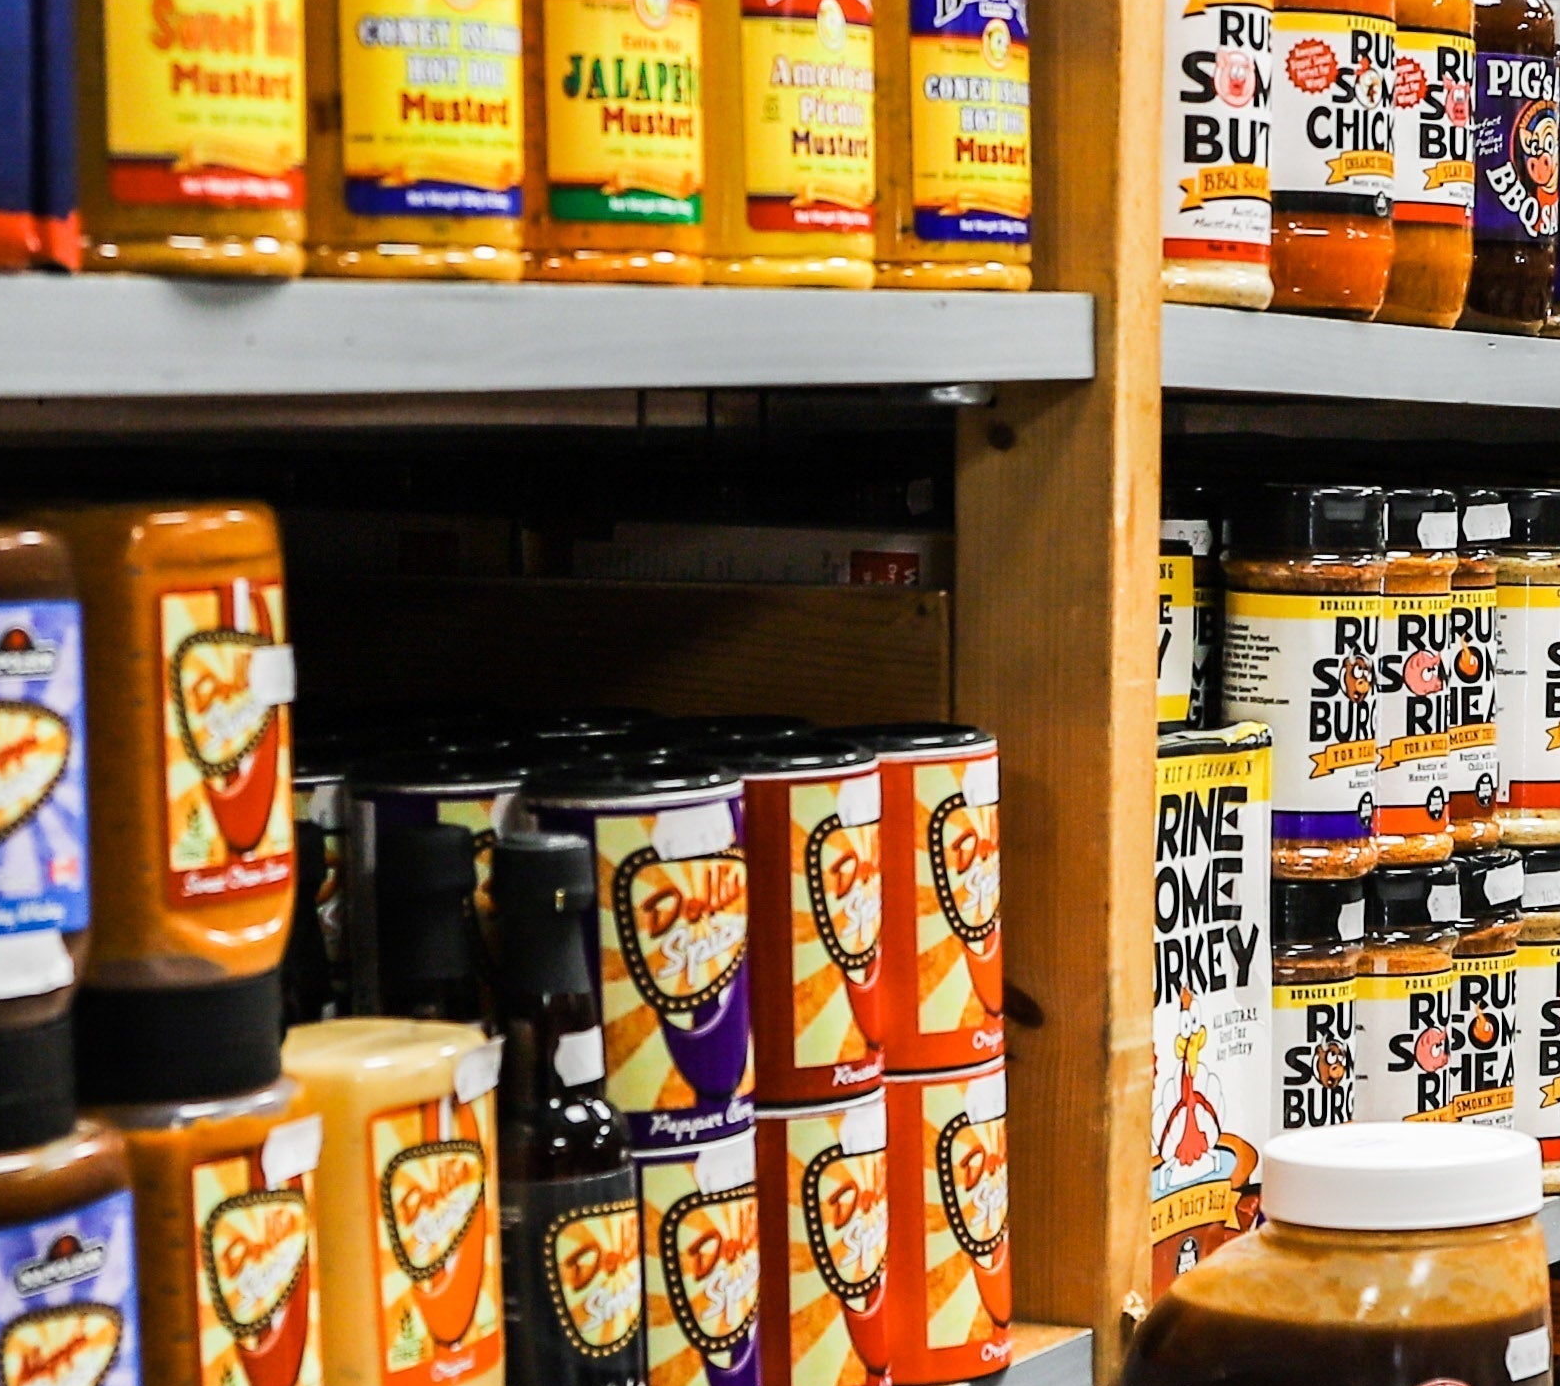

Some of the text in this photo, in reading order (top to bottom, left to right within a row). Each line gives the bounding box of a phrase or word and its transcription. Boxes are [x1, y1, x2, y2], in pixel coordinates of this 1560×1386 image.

[170, 63, 292, 99] Mustard
[1487, 60, 1552, 100] PIG's
[400, 93, 508, 126] Mustard
[600, 106, 693, 137] Mustard
[791, 129, 868, 160] Mustard
[955, 138, 1025, 166] Mustard
[1486, 162, 1540, 237] BBQ
[1392, 600, 1423, 611] PORK
[1290, 986, 1330, 1001] BURGER
[1405, 977, 1435, 990] PORK
